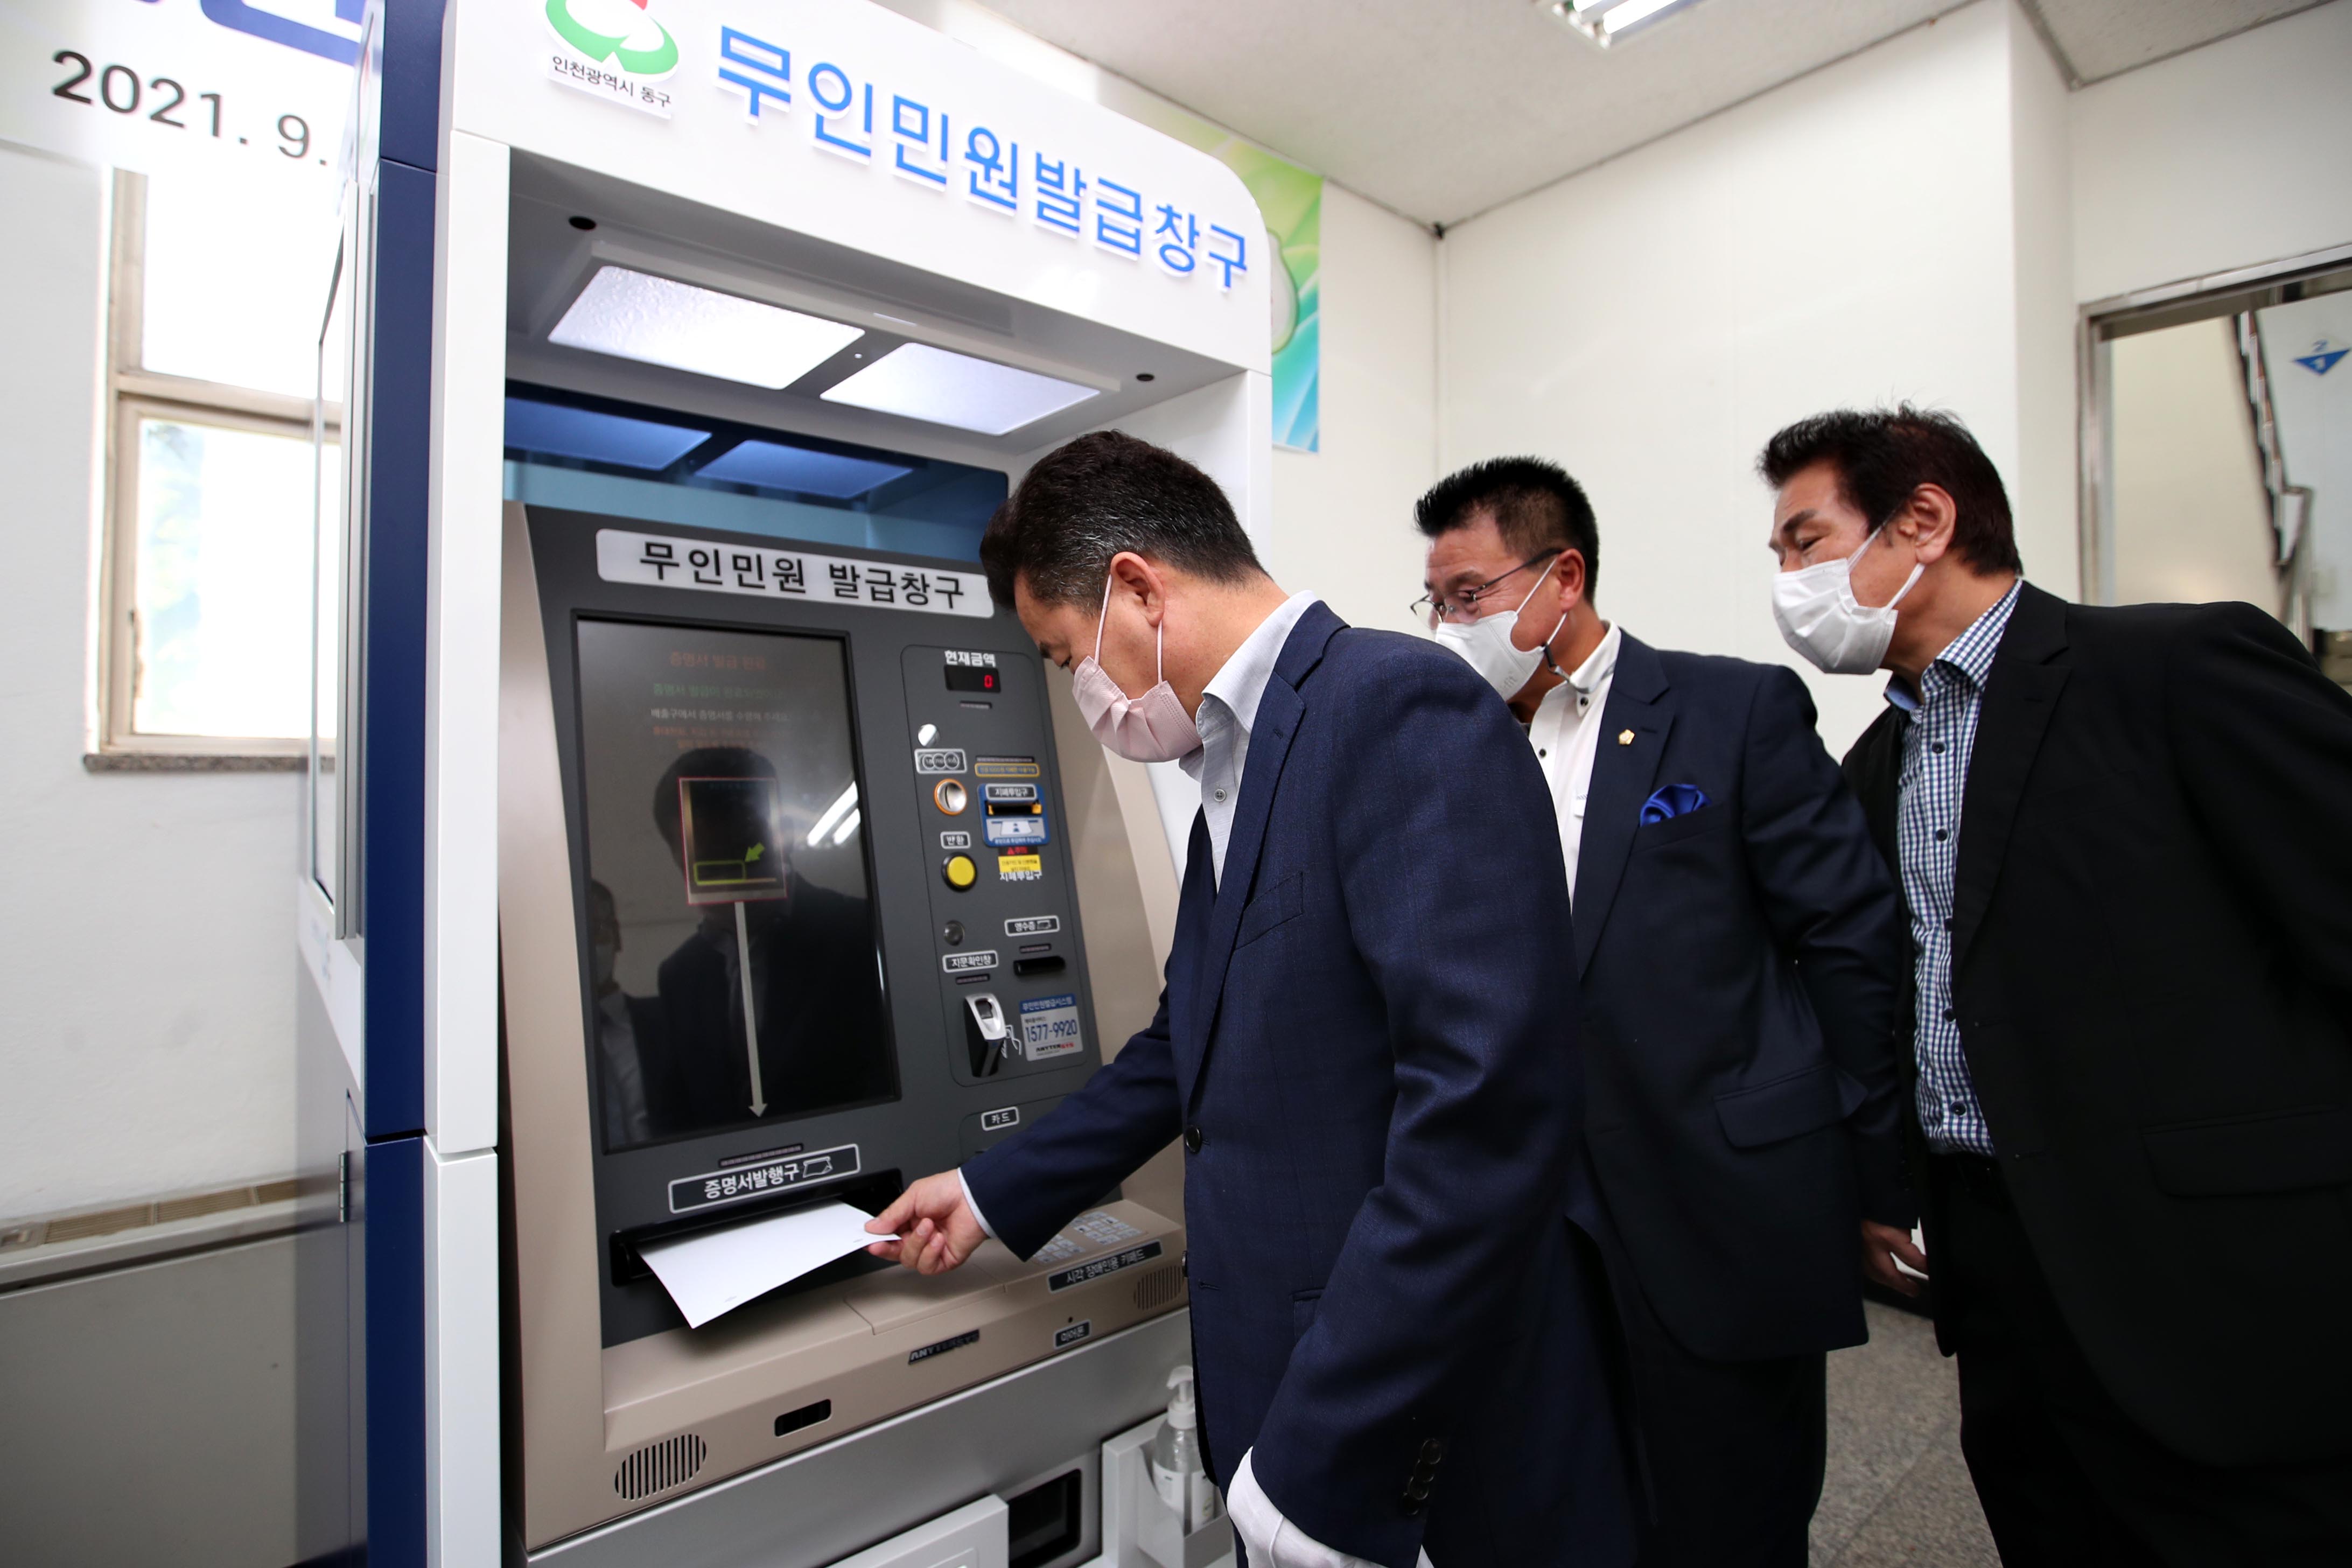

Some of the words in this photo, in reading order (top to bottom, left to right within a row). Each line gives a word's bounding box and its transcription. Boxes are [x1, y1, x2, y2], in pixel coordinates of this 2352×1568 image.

[552, 55, 634, 97] 인천광역시
[641, 86, 671, 108] 동구
[52, 50, 249, 145] 2021.
[277, 115, 327, 166] 9.
[718, 26, 1247, 289] 무인민원발급창구
[2312, 339, 2328, 352] 2
[640, 542, 806, 594] 무인민원
[829, 563, 964, 609] 발급창구
[945, 650, 996, 667] 현재금액
[984, 675, 993, 689] 0
[995, 787, 1028, 797] 지폐투입구
[947, 835, 964, 845] 반환
[1000, 870, 1042, 881] 지폐투입구
[1015, 920, 1036, 932] 영수증
[951, 955, 991, 968] 지문확인창
[1025, 1019, 1077, 1043] 1577-9920
[991, 1114, 1010, 1123] 카드
[704, 1163, 799, 1200] 증명서발행구
[1067, 1269, 1084, 1284] 시각
[1086, 1256, 1119, 1278] 장애인용
[1121, 1249, 1145, 1265] 키패드
[1061, 1326, 1084, 1342] 이어폰
